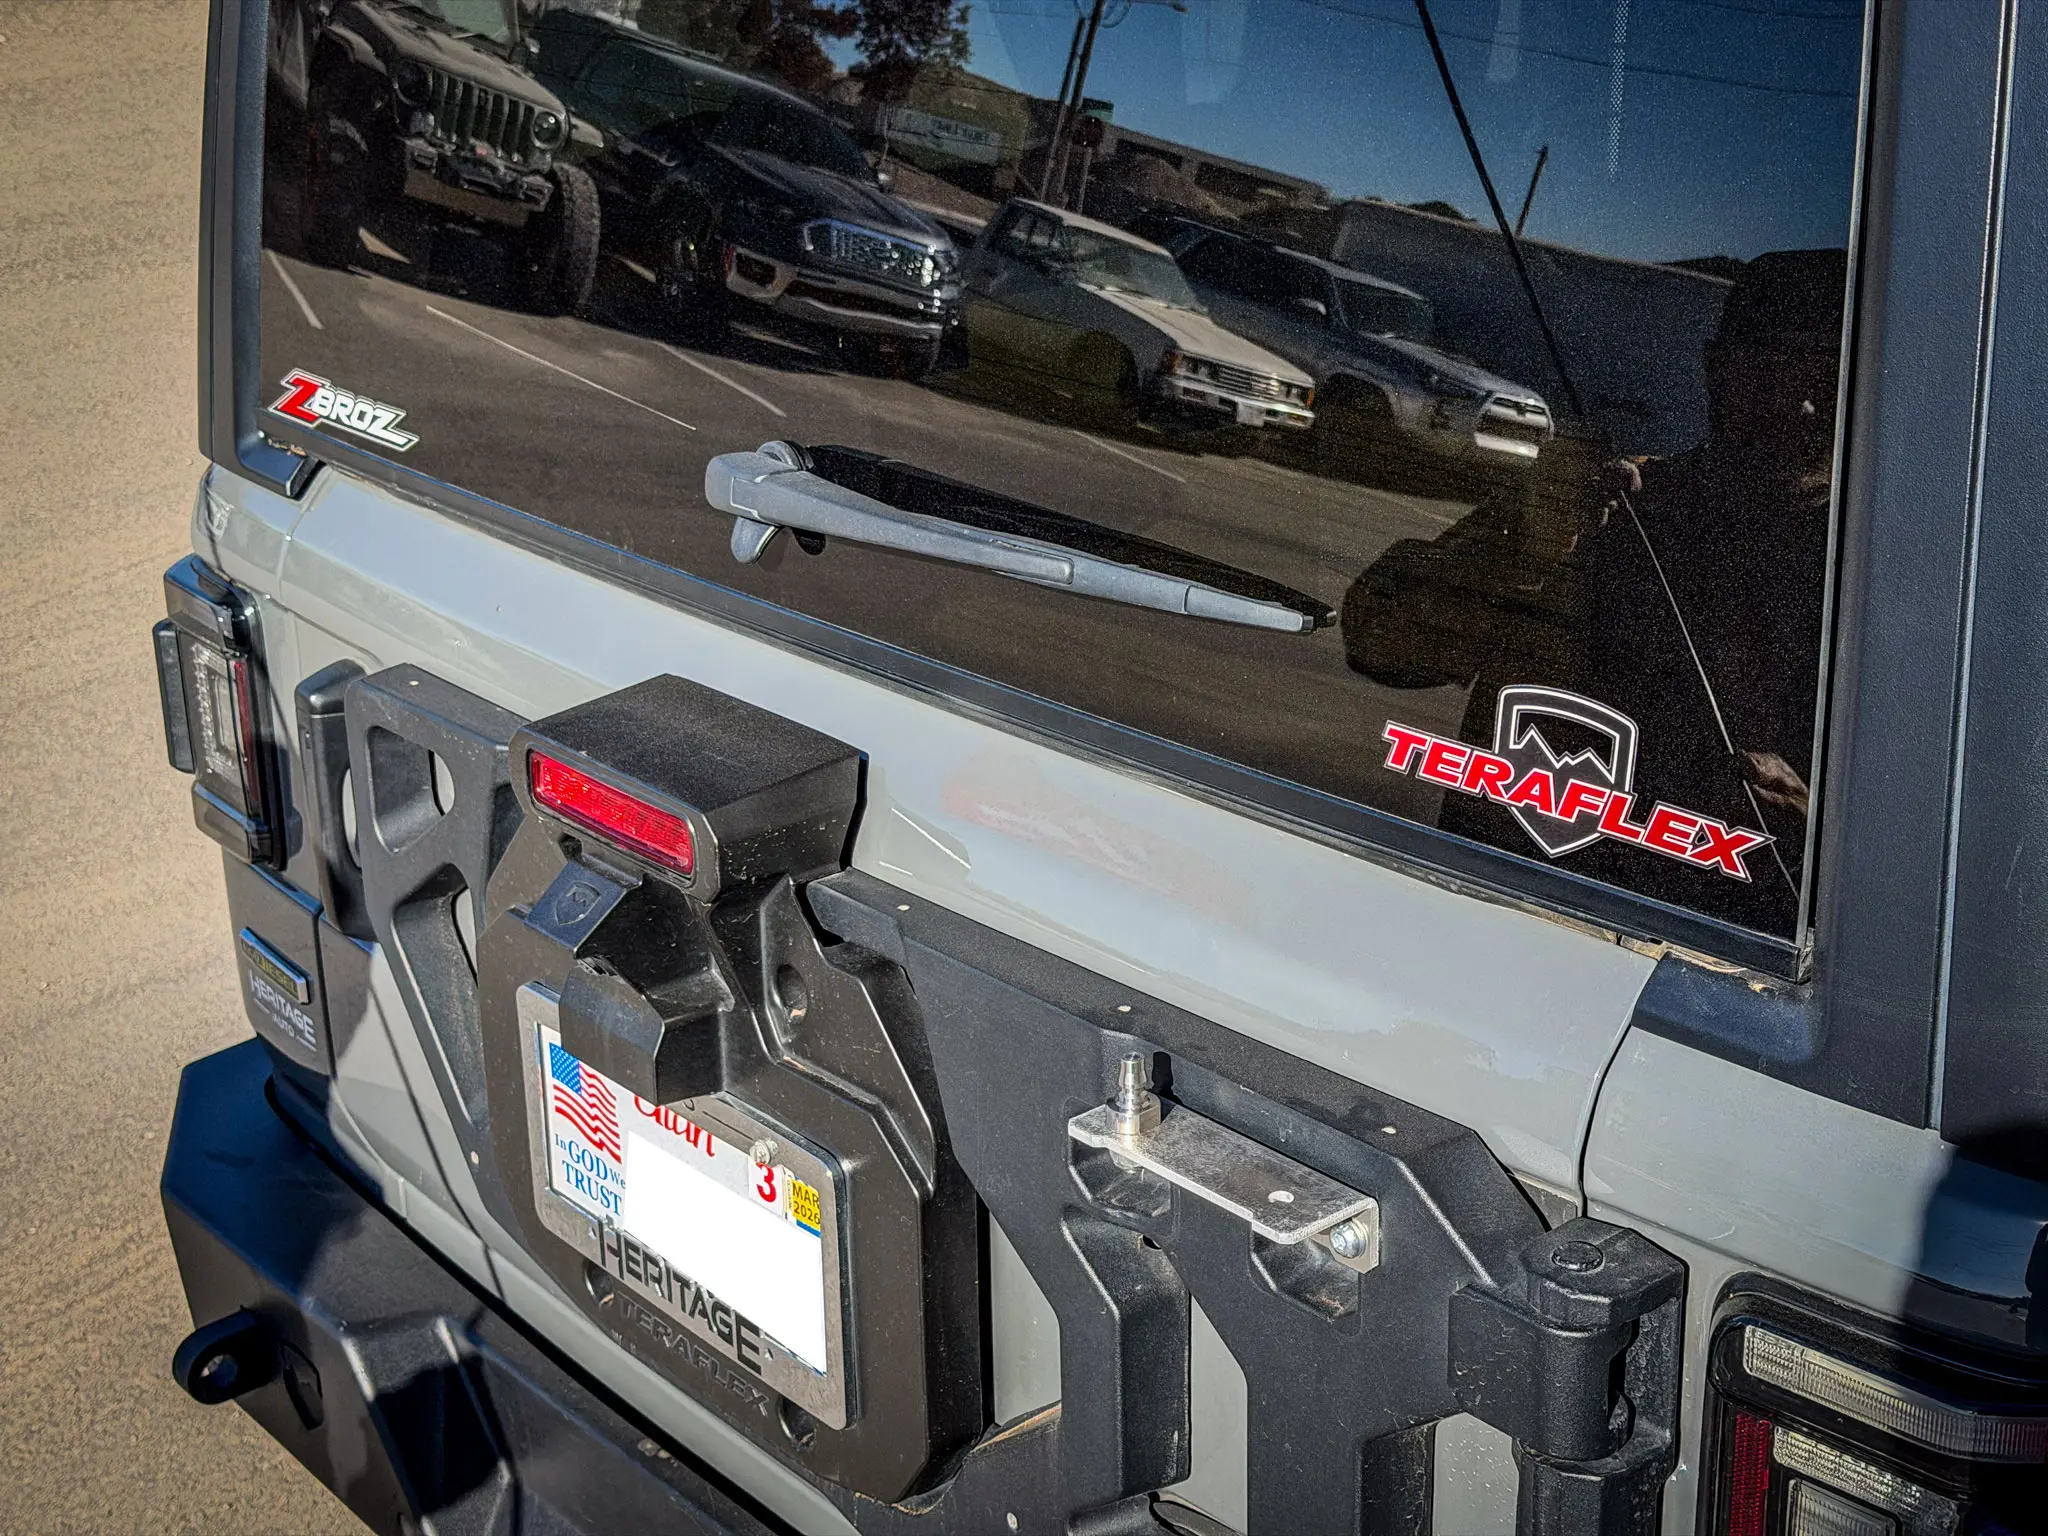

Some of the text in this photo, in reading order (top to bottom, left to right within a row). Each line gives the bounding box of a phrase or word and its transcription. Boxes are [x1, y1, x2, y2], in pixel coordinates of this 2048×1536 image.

[272, 371, 413, 449] ZBROZ
[1384, 722, 1769, 881] TERAFLEX
[248, 969, 317, 1045] HERITAGE
[272, 1013, 295, 1038] AUTO
[554, 1133, 626, 1189] In GOD We
[562, 1160, 622, 1216] TRUST
[755, 1162, 777, 1203] 3
[792, 1182, 820, 1209] MAR
[793, 1201, 821, 1225] 2026
[599, 1219, 763, 1377] HERITAGE
[615, 1290, 770, 1417] TERAFLEX
